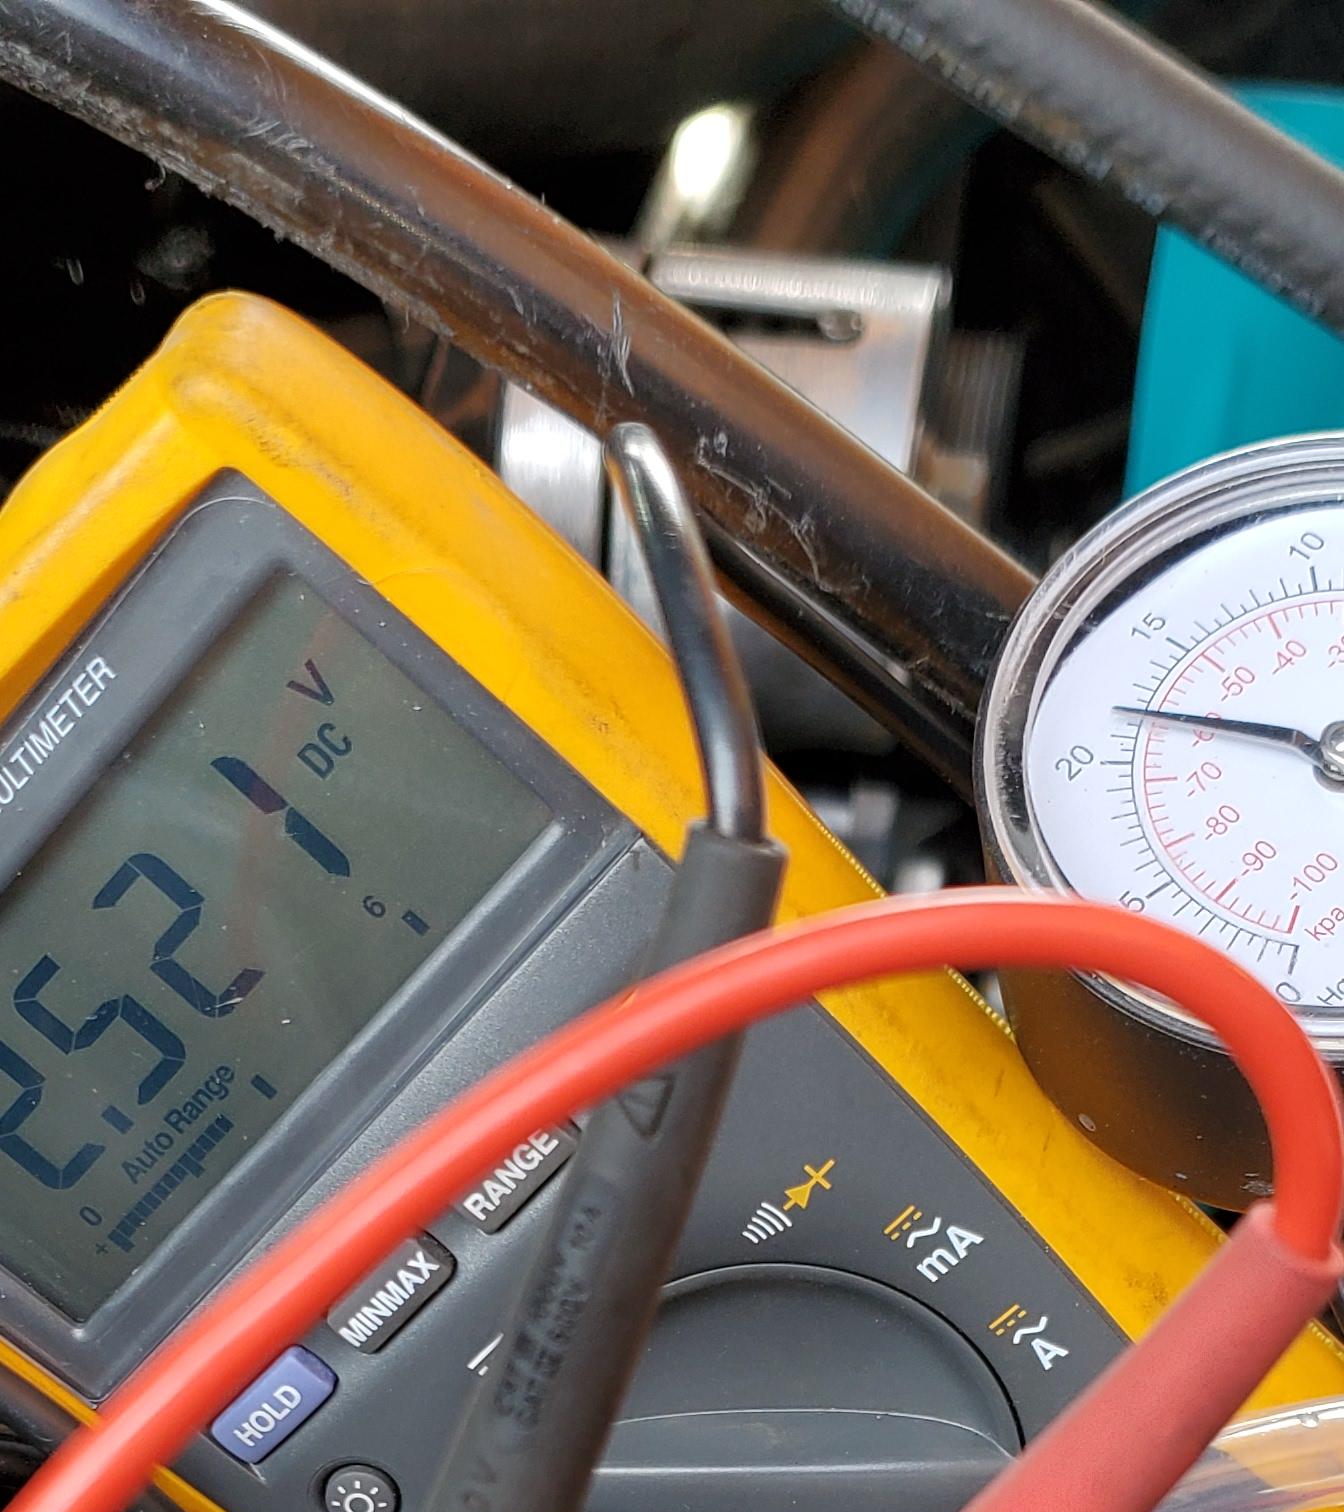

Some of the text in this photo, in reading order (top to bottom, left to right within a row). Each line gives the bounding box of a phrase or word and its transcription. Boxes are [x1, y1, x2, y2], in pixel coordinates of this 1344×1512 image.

[1289, 532, 1324, 560] 10
[1131, 612, 1166, 640] 15
[1272, 640, 1307, 676] -40
[286, 659, 335, 706] V
[1221, 667, 1256, 702] -50
[297, 722, 352, 779] DC
[1055, 745, 1094, 781] 20
[1186, 762, 1223, 797] -70
[1205, 805, 1241, 840] -80
[1241, 841, 1277, 877] -90
[1289, 852, 1339, 900] -100
[362, 895, 386, 918] 6
[1118, 889, 1145, 914] 5
[122, 1066, 235, 1184] Auto Range
[463, 1129, 559, 1221] RANGE
[79, 1206, 102, 1226] 0
[916, 1225, 984, 1283] mA
[338, 1251, 440, 1347] MINMAX
[1031, 1338, 1069, 1370] A
[233, 1385, 302, 1446] HOLD
